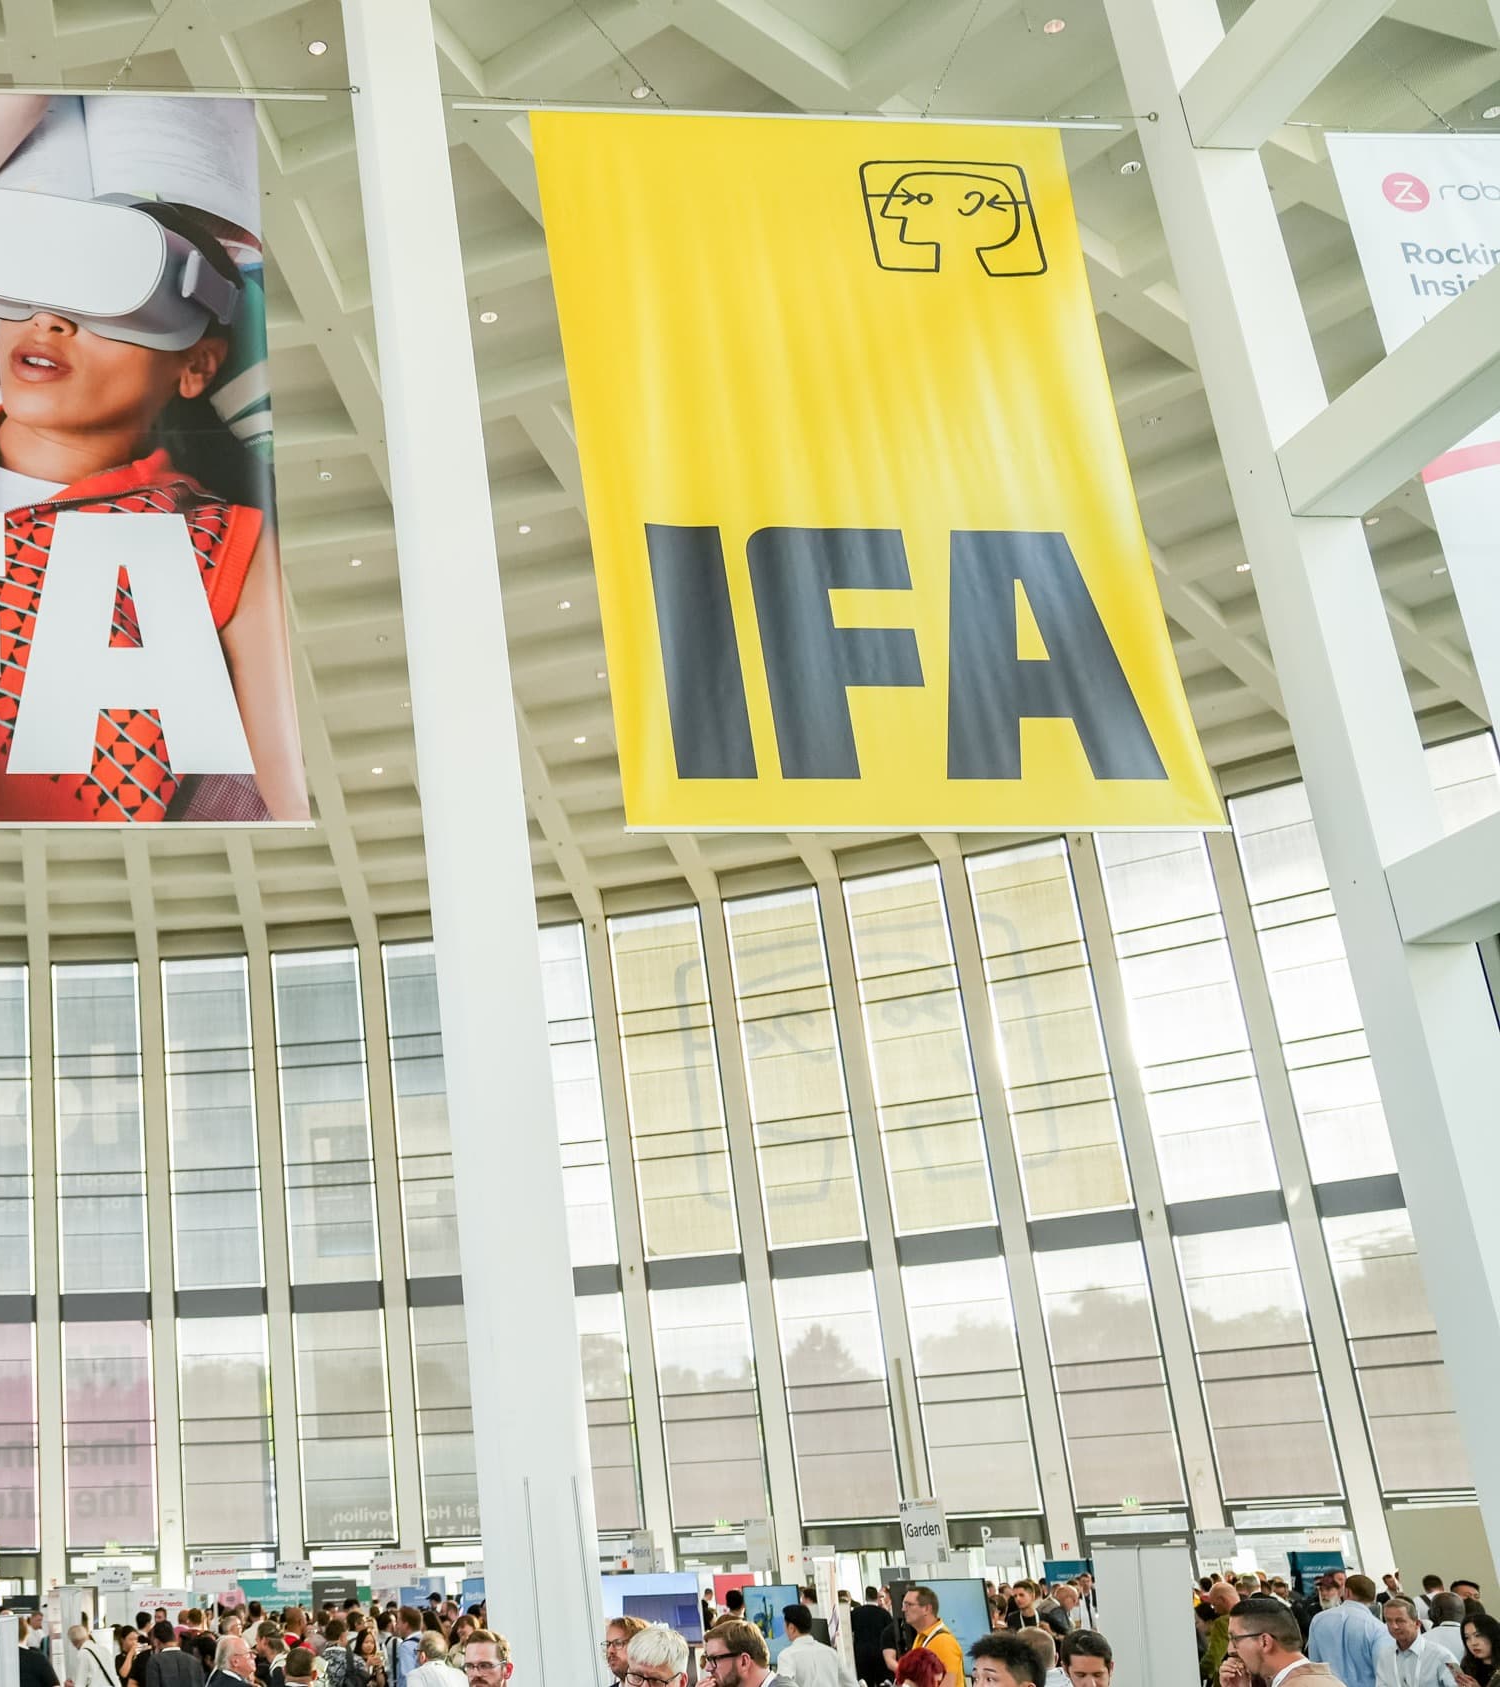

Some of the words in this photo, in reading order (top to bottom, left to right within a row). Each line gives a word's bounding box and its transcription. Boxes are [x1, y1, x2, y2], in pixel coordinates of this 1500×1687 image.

[644, 523, 1169, 780] IFA
[903, 1520, 941, 1539] iGarden
[375, 1562, 417, 1571] SwitchBot
